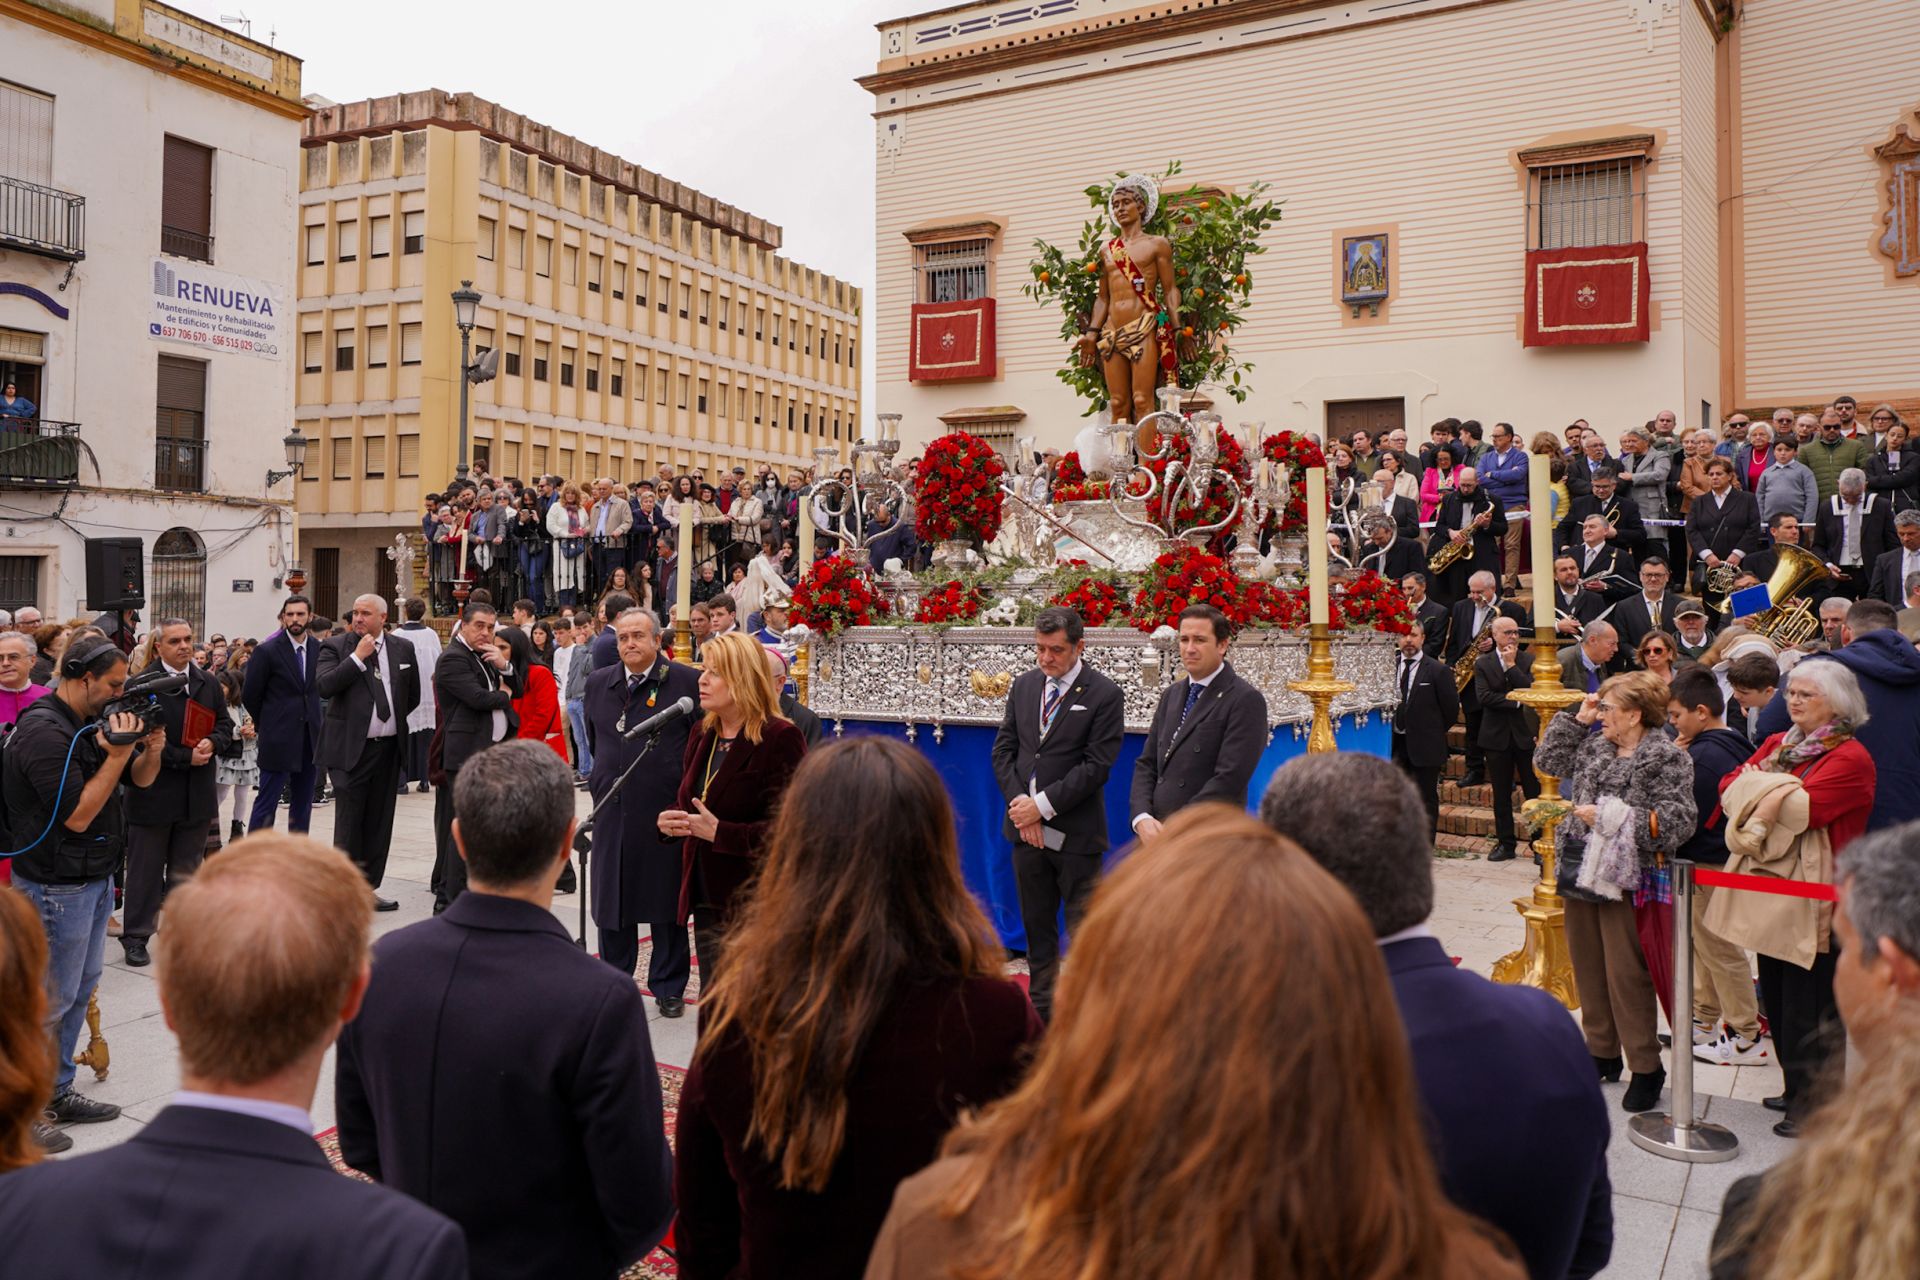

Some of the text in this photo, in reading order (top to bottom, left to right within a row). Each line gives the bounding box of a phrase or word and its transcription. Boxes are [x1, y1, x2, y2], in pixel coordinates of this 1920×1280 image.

[177, 280, 273, 317] RENUEVA
[156, 301, 217, 320] Mantenimiento
[225, 314, 276, 331] Rehabilitación
[166, 314, 177, 323] de
[178, 316, 210, 329] Edificios
[218, 323, 267, 340] Comunidades
[162, 326, 176, 337] 637
[178, 328, 191, 340] 706
[193, 331, 207, 342] 670
[212, 335, 225, 346] 656
[226, 337, 239, 348] 515
[240, 339, 253, 351] 029
